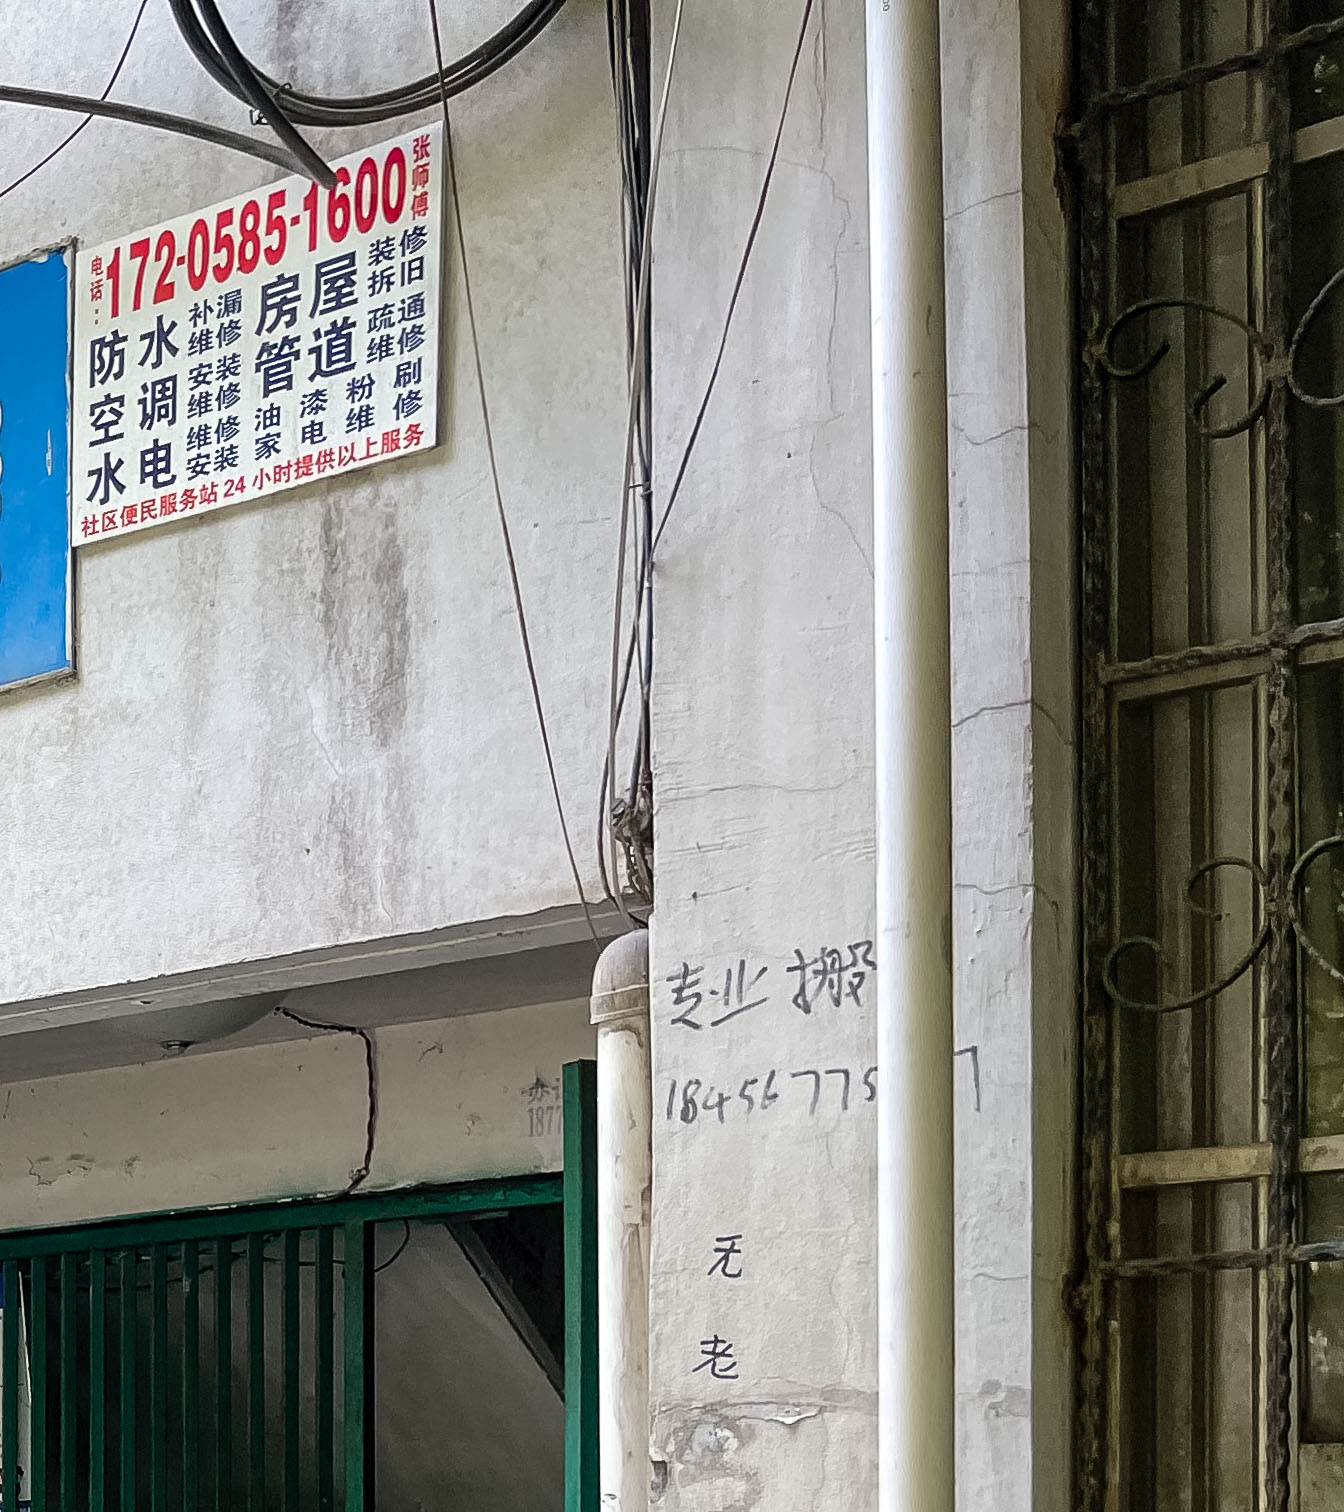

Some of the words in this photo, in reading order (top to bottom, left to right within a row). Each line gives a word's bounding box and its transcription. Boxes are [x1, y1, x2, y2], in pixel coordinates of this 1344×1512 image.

[410, 132, 432, 222] 张师傅
[105, 146, 406, 320] 172-0585-1600
[368, 226, 429, 267] 装修
[255, 250, 360, 337] 房屋
[367, 256, 425, 297] 拆旧
[188, 287, 244, 325] 补漏
[367, 291, 426, 334] 疏通
[89, 313, 180, 389] 防水
[188, 319, 243, 357] 维修
[254, 317, 358, 399] 管道
[366, 323, 426, 364] 维修
[188, 352, 243, 391] 安装
[88, 374, 179, 448] 空调
[187, 383, 242, 420] 维修
[186, 415, 242, 452] 维修
[87, 439, 178, 506] 水电
[186, 445, 241, 482] 安装
